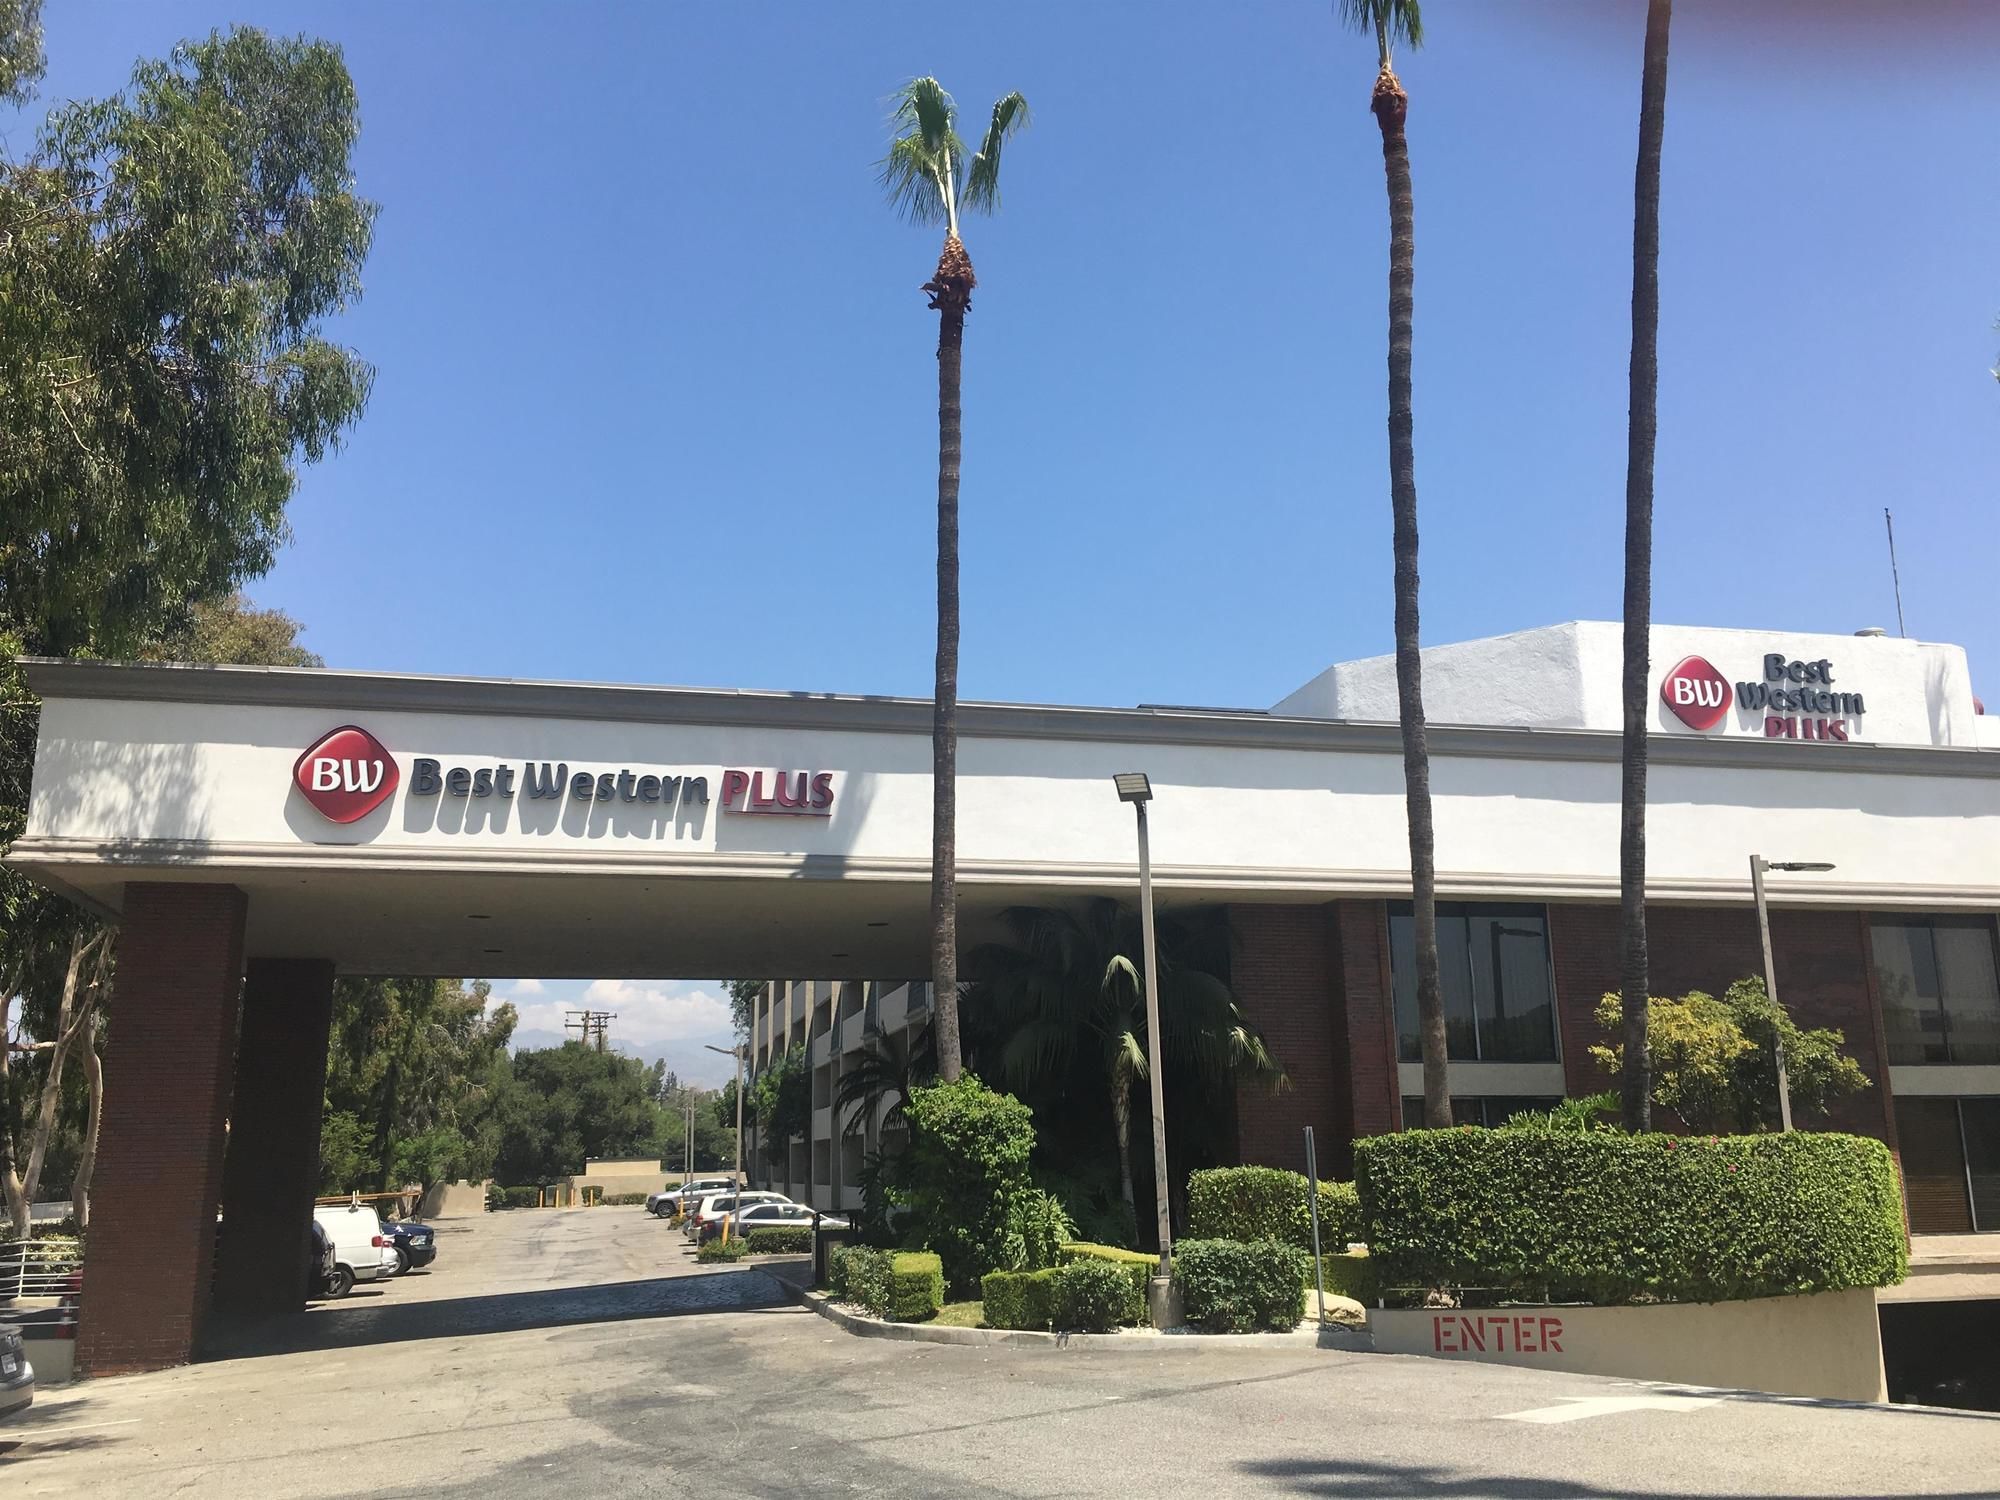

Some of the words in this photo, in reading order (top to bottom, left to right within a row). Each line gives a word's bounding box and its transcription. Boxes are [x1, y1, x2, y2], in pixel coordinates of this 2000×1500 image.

[1763, 653, 1835, 684] Best
[1673, 677, 1723, 708] BW
[1735, 681, 1866, 715] Western
[311, 757, 384, 793] BW
[412, 758, 515, 798] Best
[524, 762, 710, 805] Western
[722, 769, 835, 809] PLUS
[1434, 1316, 1564, 1353] ENTER
